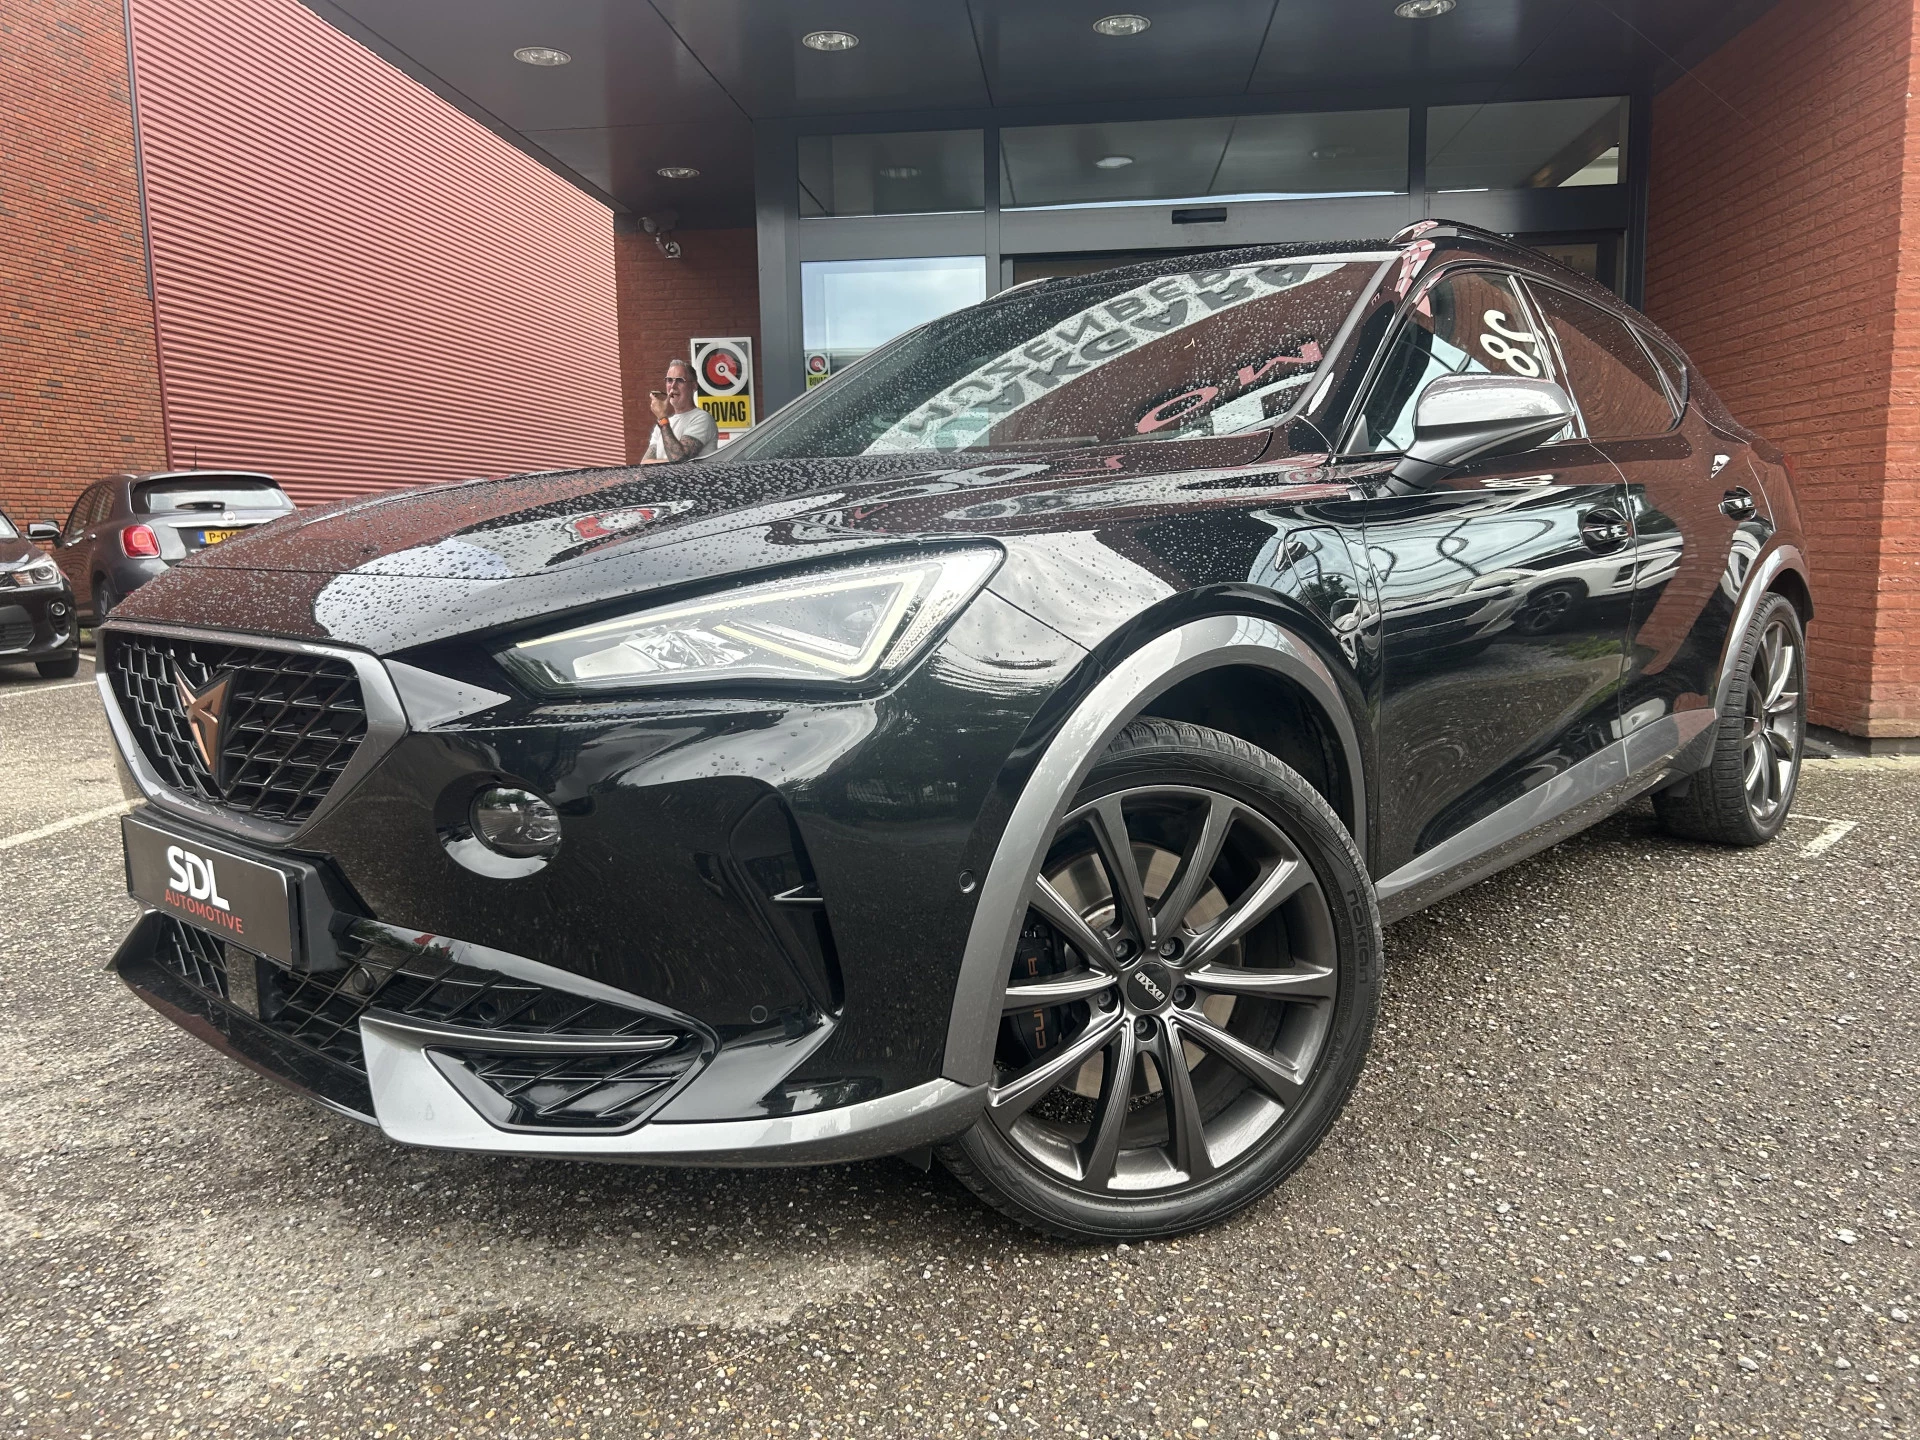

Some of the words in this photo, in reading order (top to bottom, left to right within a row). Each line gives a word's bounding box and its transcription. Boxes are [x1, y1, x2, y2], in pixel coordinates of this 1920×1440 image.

[164, 888, 244, 934] AUTOMOTIVE
[167, 845, 230, 911] SDL
[1027, 957, 1047, 1049] CUA
